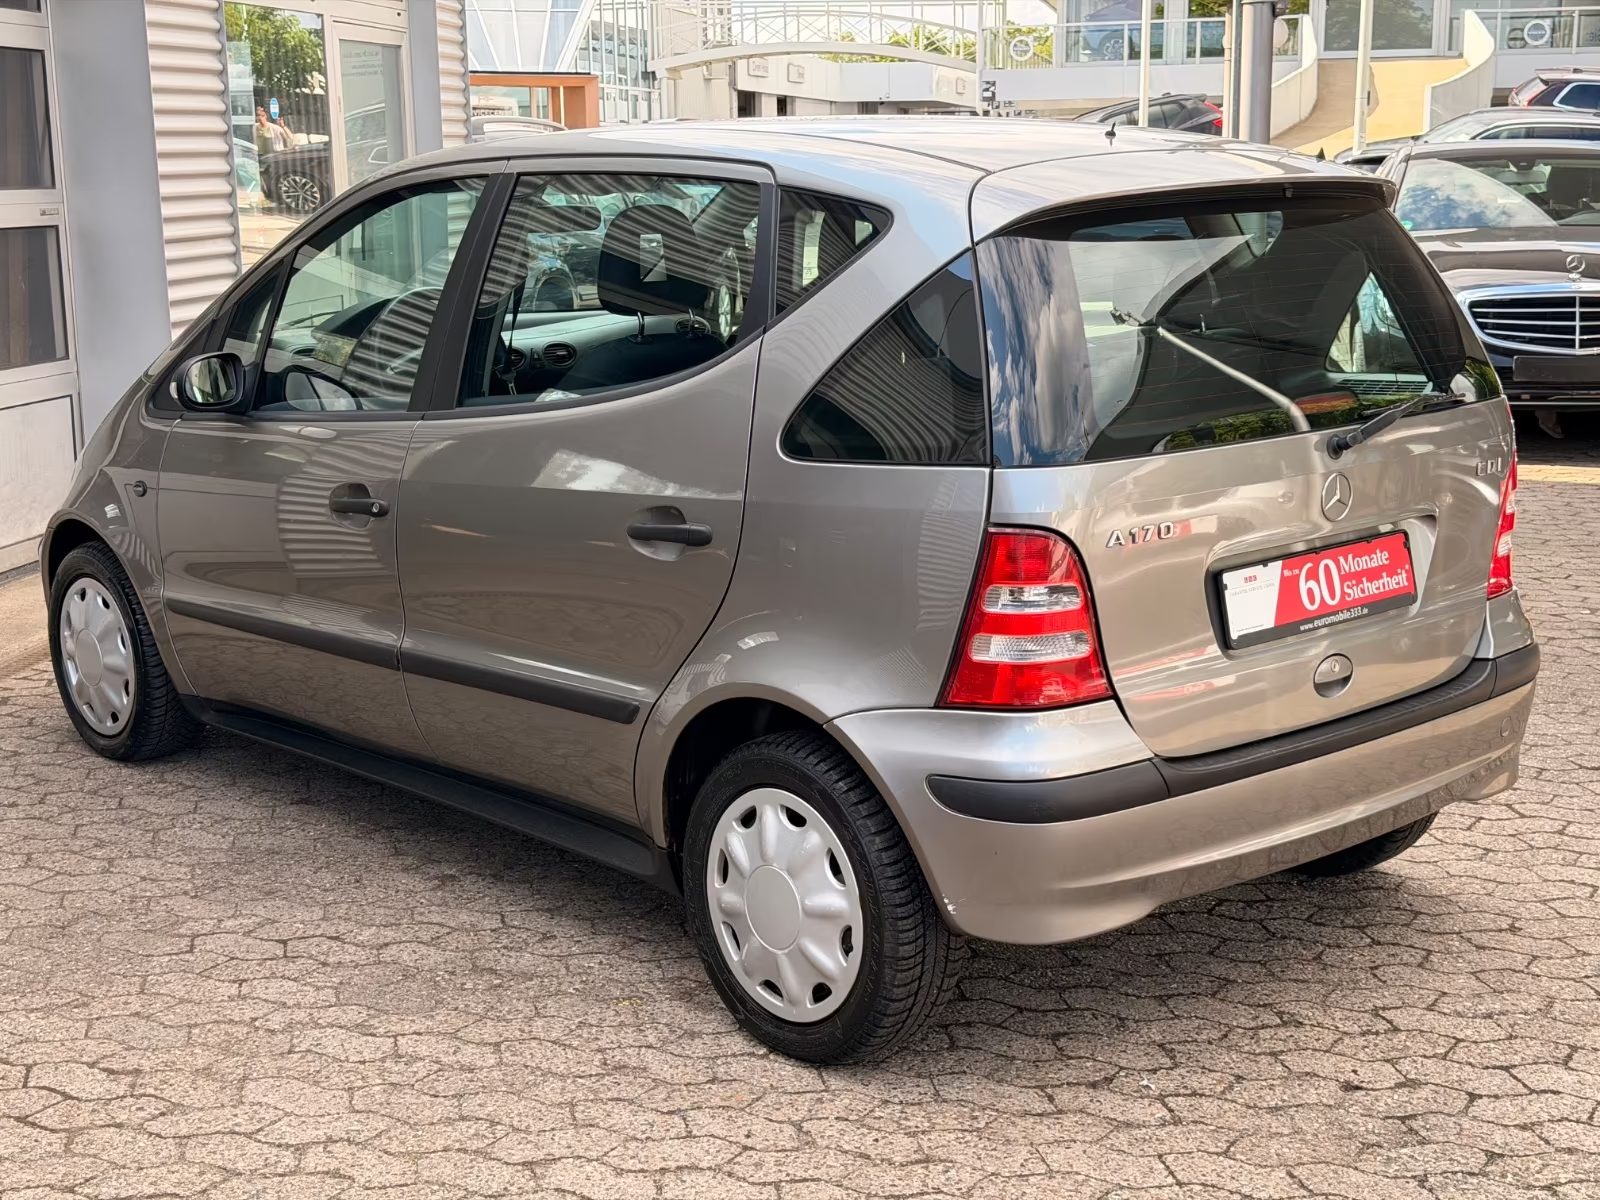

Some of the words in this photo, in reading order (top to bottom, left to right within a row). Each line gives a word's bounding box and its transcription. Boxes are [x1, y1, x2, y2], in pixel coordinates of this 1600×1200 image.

[1476, 457, 1502, 476] CDI
[1338, 549, 1390, 574] Monate
[1299, 558, 1341, 611] 60
[1300, 606, 1369, 631] www.euromobile333.de
